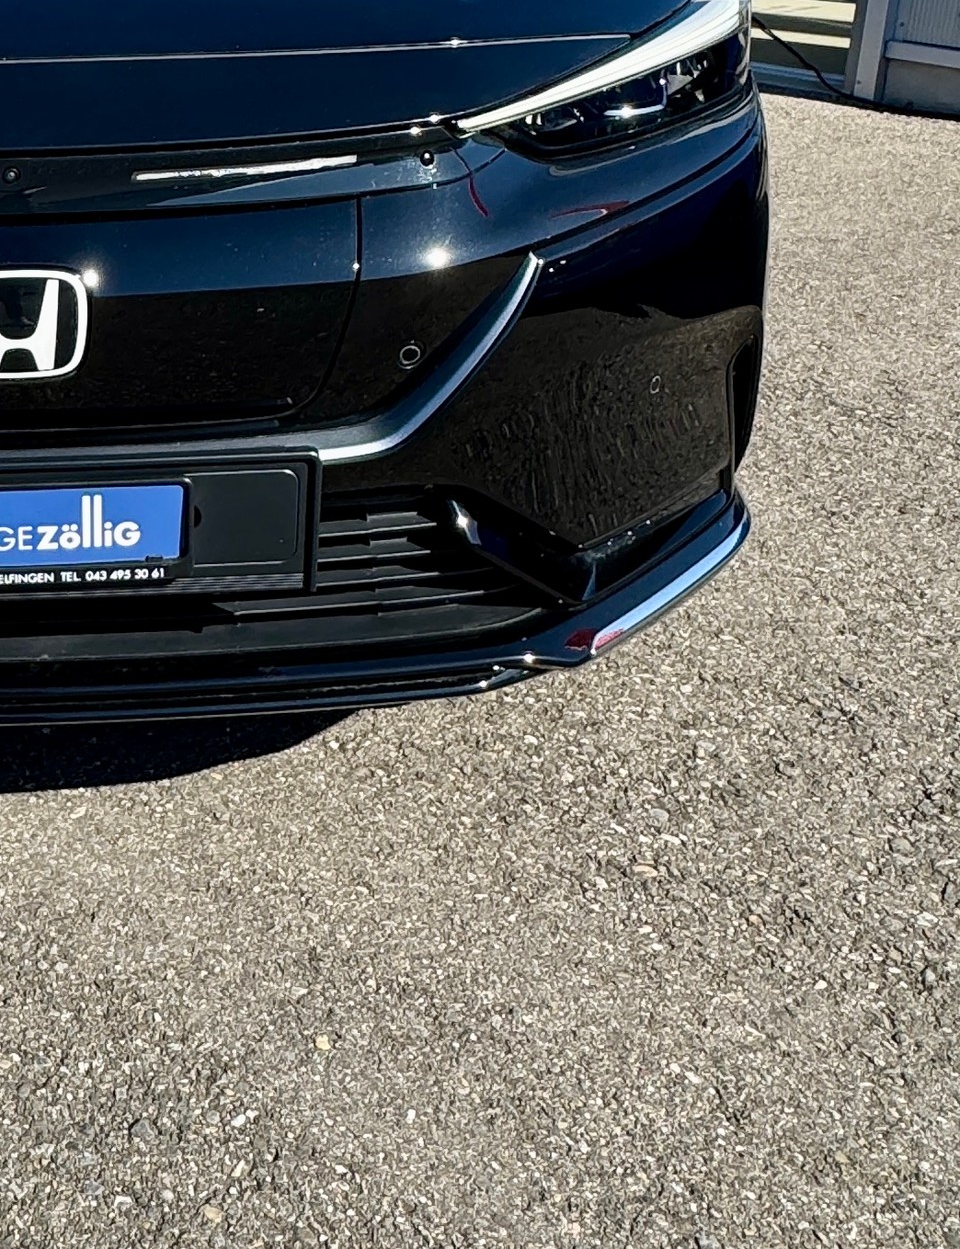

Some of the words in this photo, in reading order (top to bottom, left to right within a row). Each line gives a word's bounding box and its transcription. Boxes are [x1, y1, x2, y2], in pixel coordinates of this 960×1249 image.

[85, 570, 107, 581] 043
[110, 569, 132, 580] 495
[134, 568, 149, 579] 30
[151, 567, 165, 579] 61
